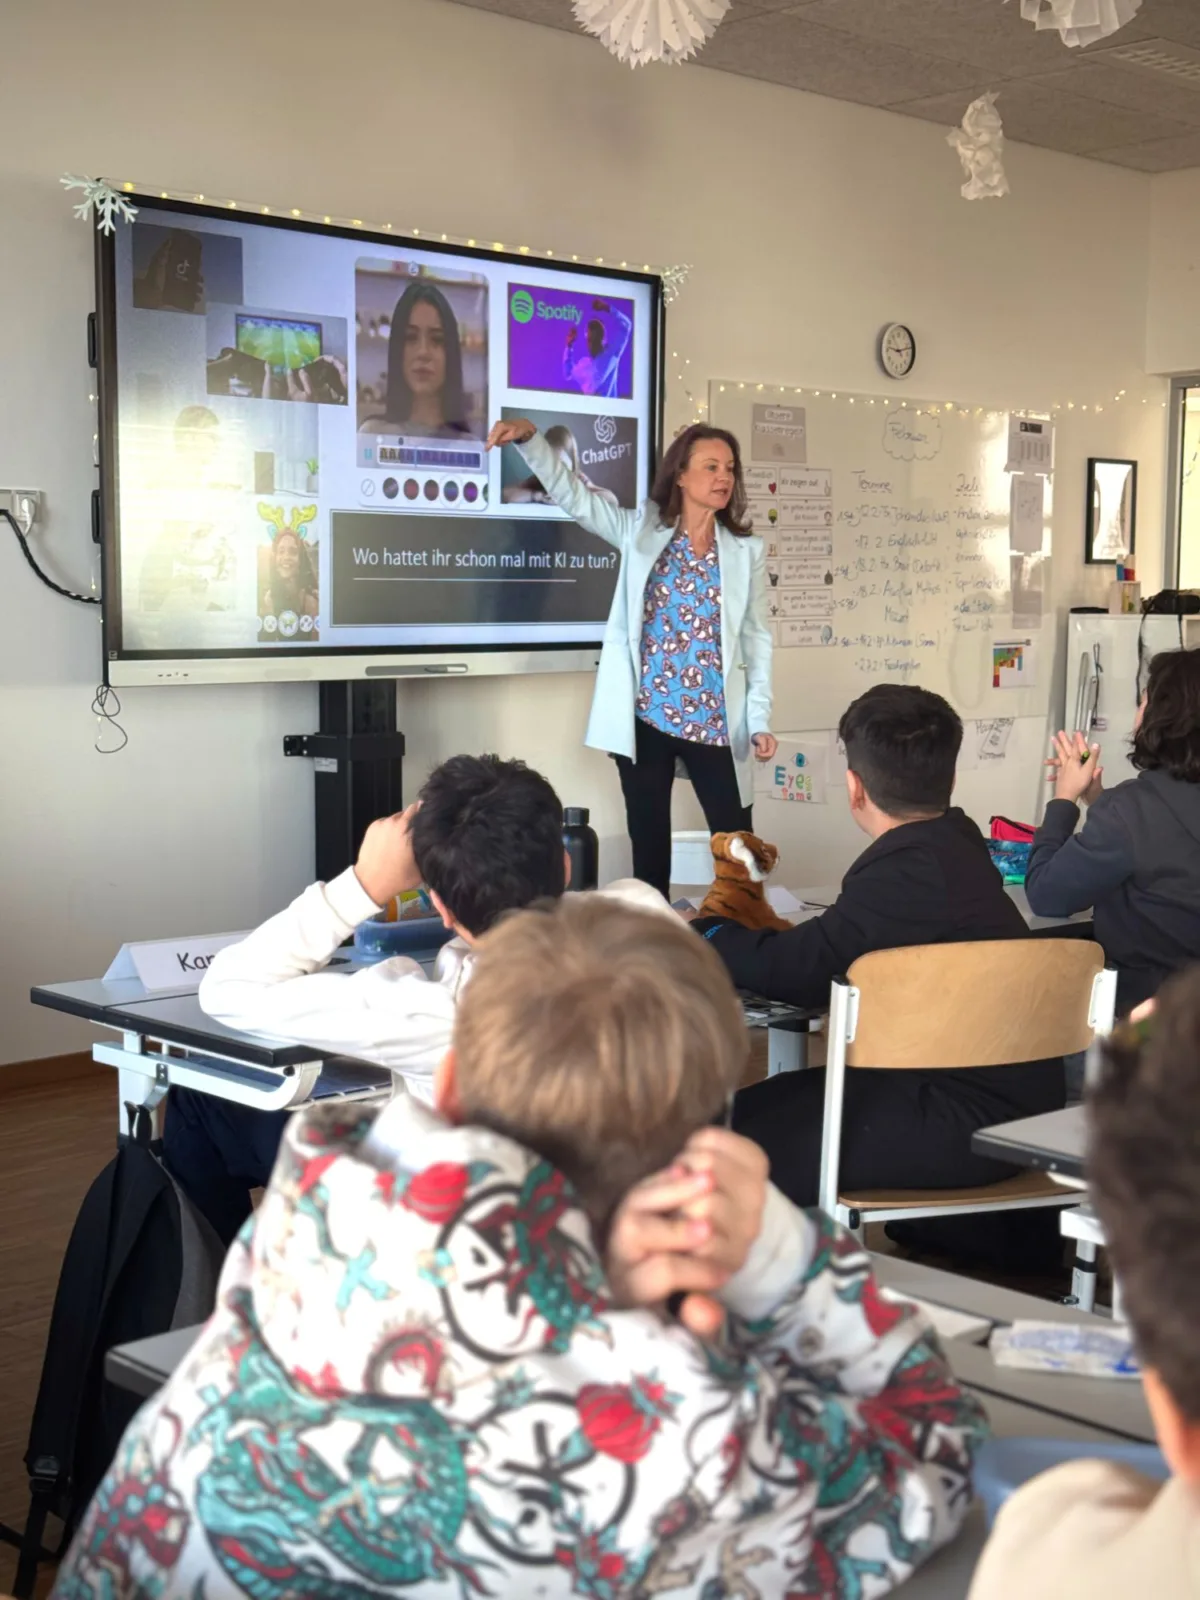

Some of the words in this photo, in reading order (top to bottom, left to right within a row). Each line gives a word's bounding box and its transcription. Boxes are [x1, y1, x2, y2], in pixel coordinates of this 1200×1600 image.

[536, 301, 583, 325] Spotify
[581, 442, 632, 465] ChatGPT
[352, 547, 379, 566] Wo
[383, 547, 428, 567] hattet
[432, 548, 451, 567] ihr
[455, 549, 496, 568] schon
[500, 551, 525, 568] mal
[529, 551, 552, 568] mit
[554, 552, 567, 569] KI
[569, 555, 585, 569] zu
[588, 552, 618, 569] tun?
[774, 765, 813, 792] Eyes
